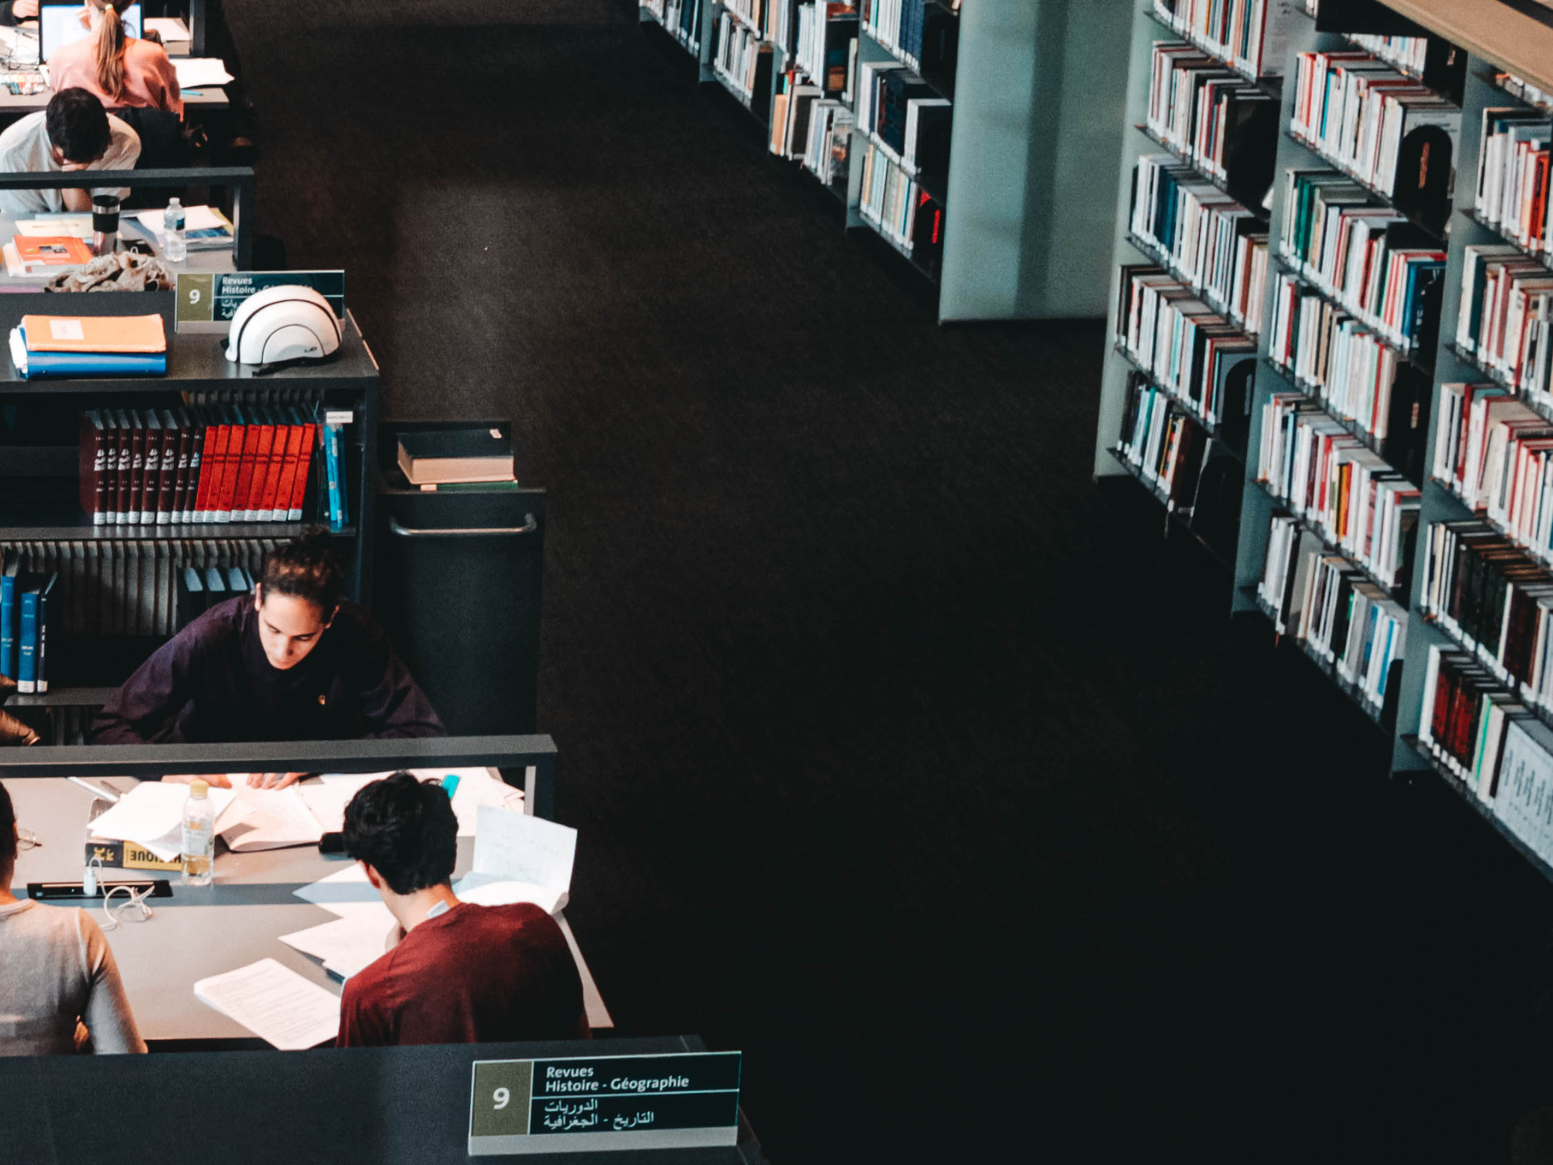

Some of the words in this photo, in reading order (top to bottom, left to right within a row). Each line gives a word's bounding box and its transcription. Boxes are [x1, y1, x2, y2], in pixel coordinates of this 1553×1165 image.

[222, 276, 252, 285] Revues
[188, 289, 201, 305] 9
[221, 285, 255, 294] Histoire
[546, 1066, 594, 1078] Revues
[545, 1079, 599, 1092] Histoire
[610, 1076, 689, 1092] Géographie
[492, 1087, 510, 1110] 9
[544, 1098, 598, 1115] الدوريات
[543, 1113, 599, 1130] الجغرافية
[612, 1111, 655, 1130] التاريخ
